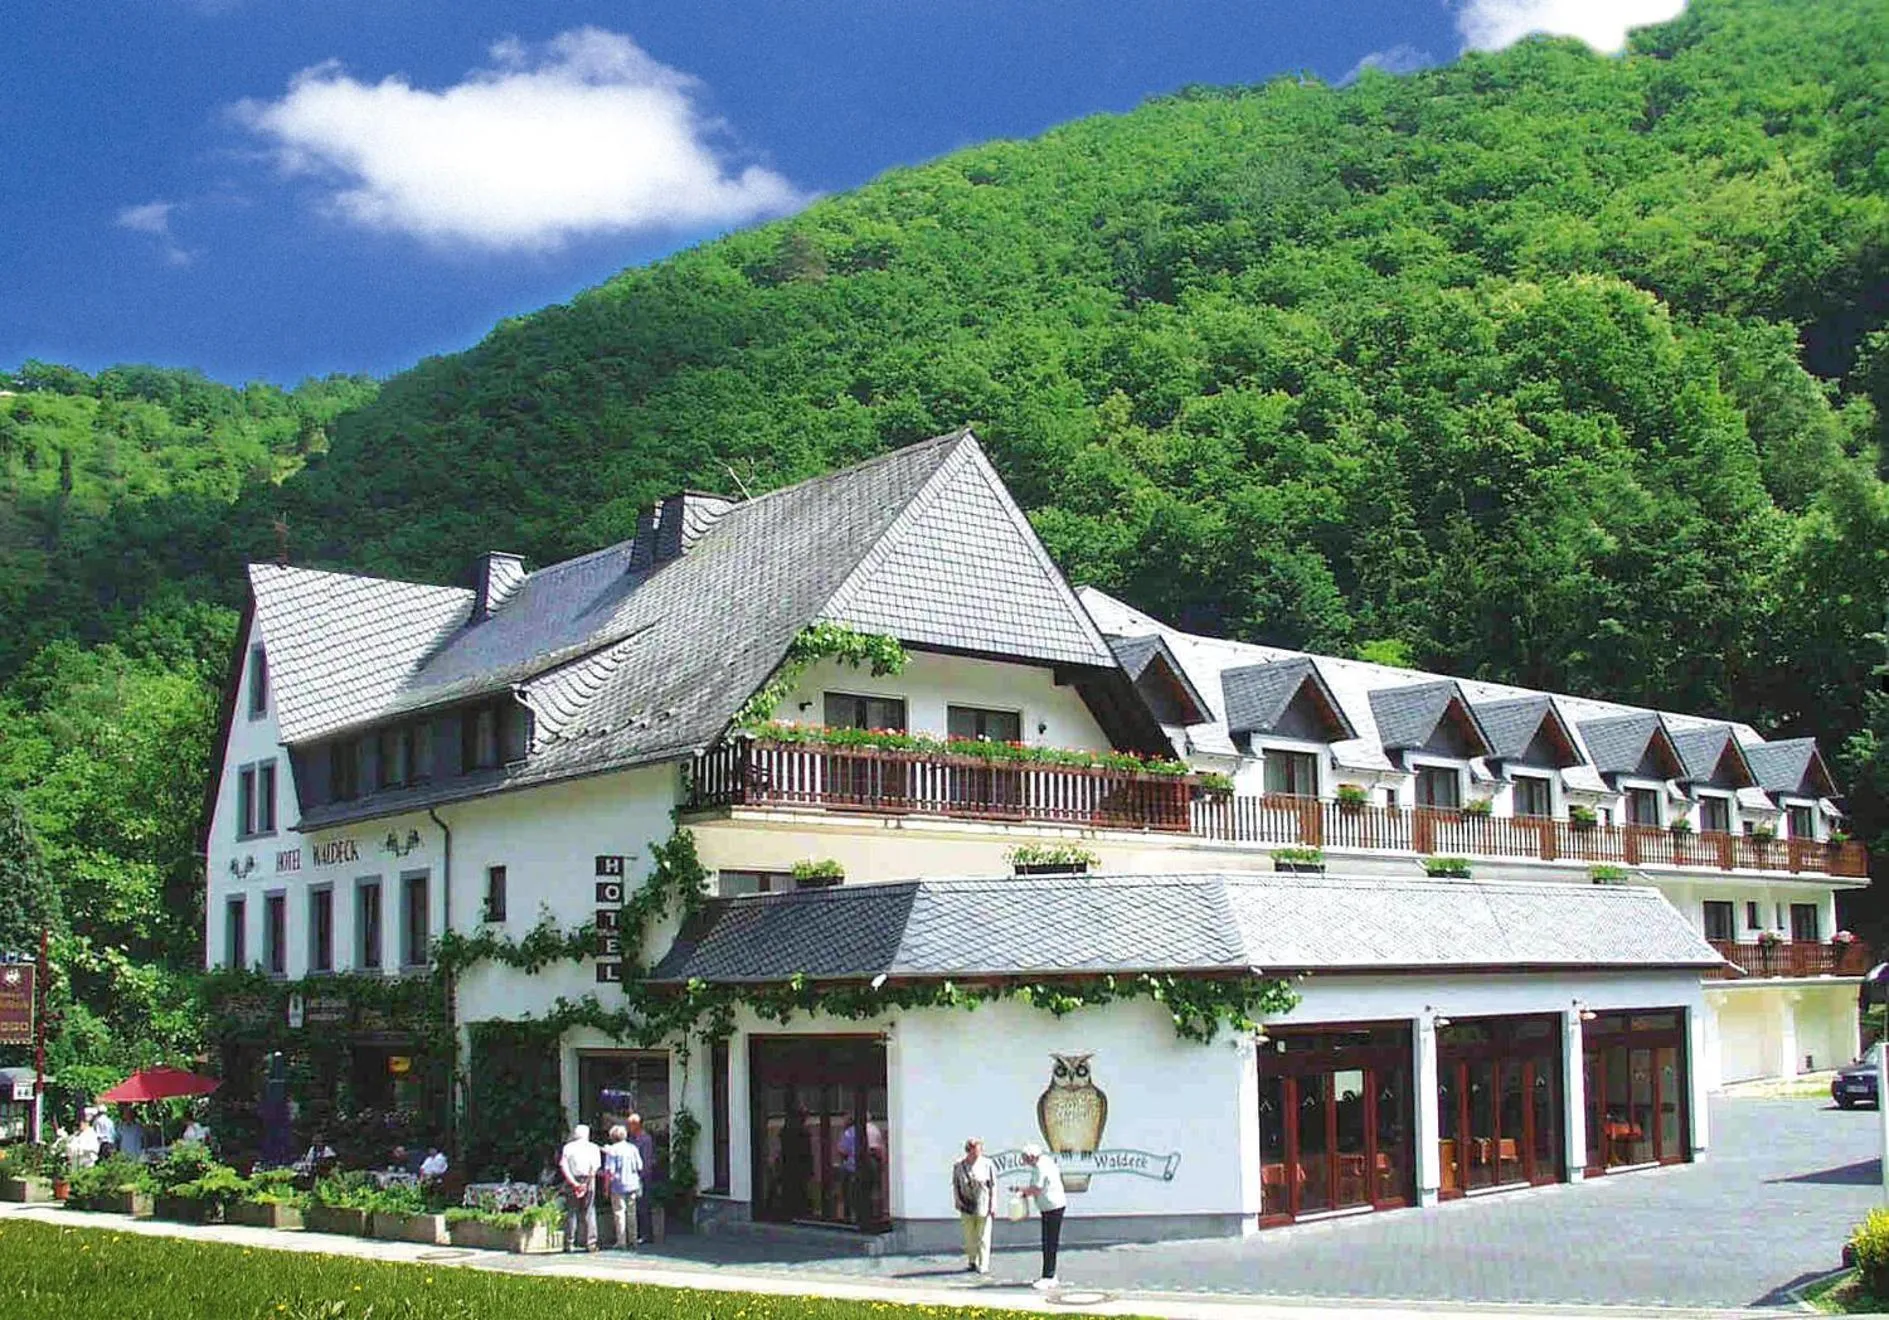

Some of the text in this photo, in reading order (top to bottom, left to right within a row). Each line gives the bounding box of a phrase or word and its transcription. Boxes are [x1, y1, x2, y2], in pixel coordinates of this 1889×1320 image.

[276, 840, 360, 872] HOTEL WALDECK
[605, 858, 620, 981] HOTEL
[1094, 1151, 1147, 1168] Waldeck
